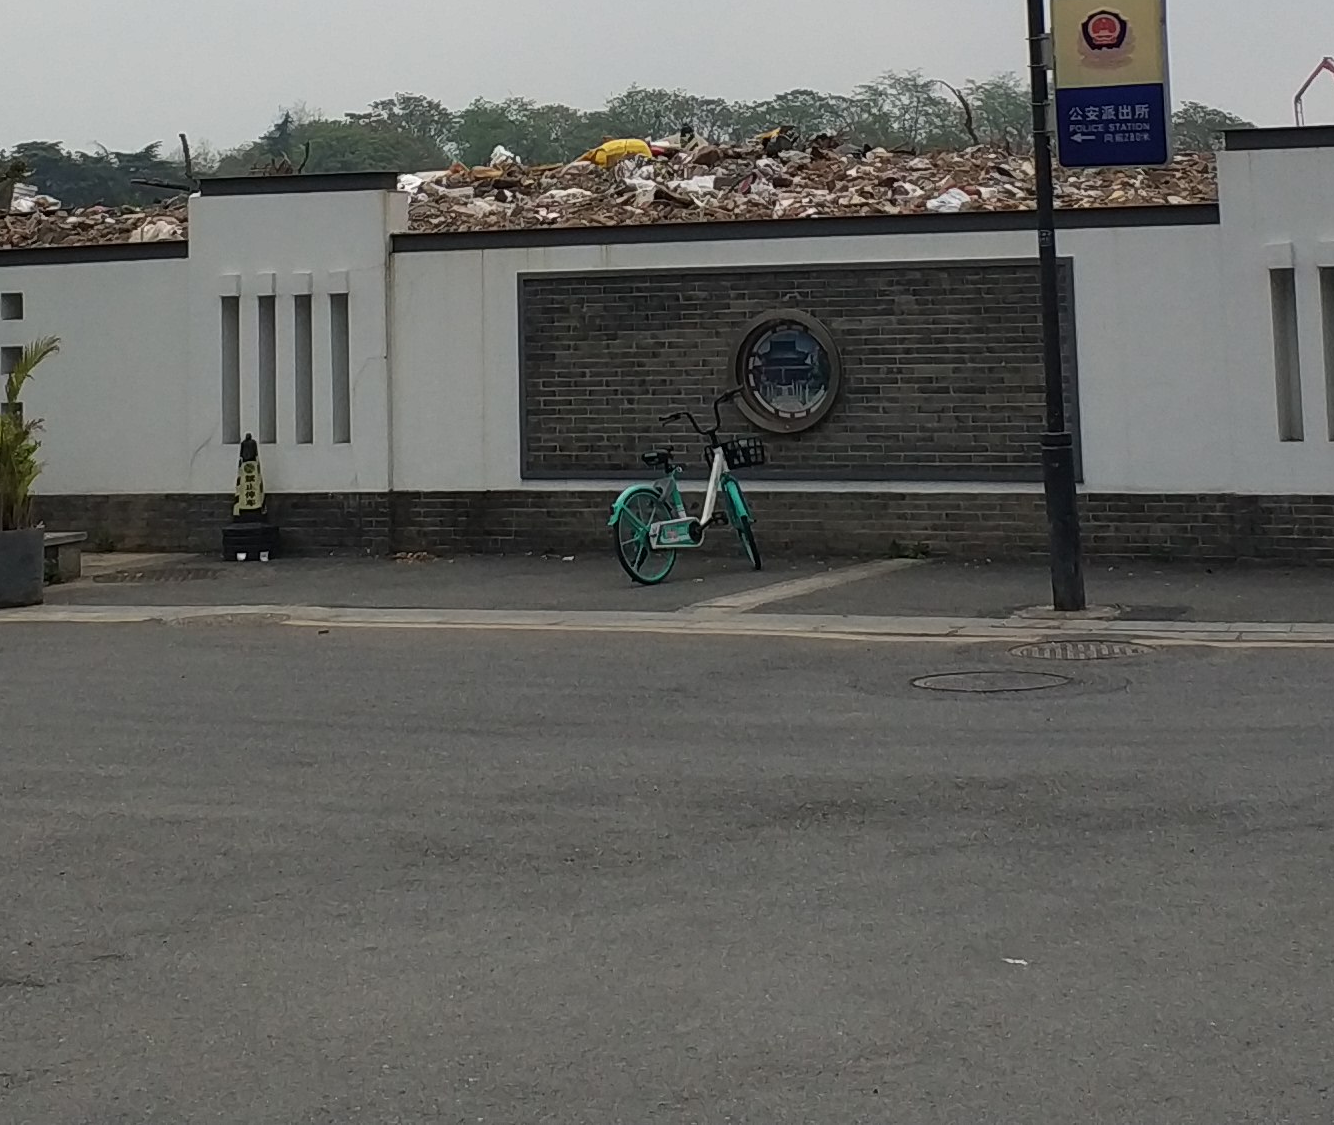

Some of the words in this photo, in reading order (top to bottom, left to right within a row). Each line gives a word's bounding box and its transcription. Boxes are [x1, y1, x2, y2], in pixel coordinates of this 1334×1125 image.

[1069, 104, 1150, 121] 公安派出所
[1069, 123, 1105, 132] POLICE
[1108, 123, 1150, 131] STATION
[245, 475, 256, 507] 禁止停车
